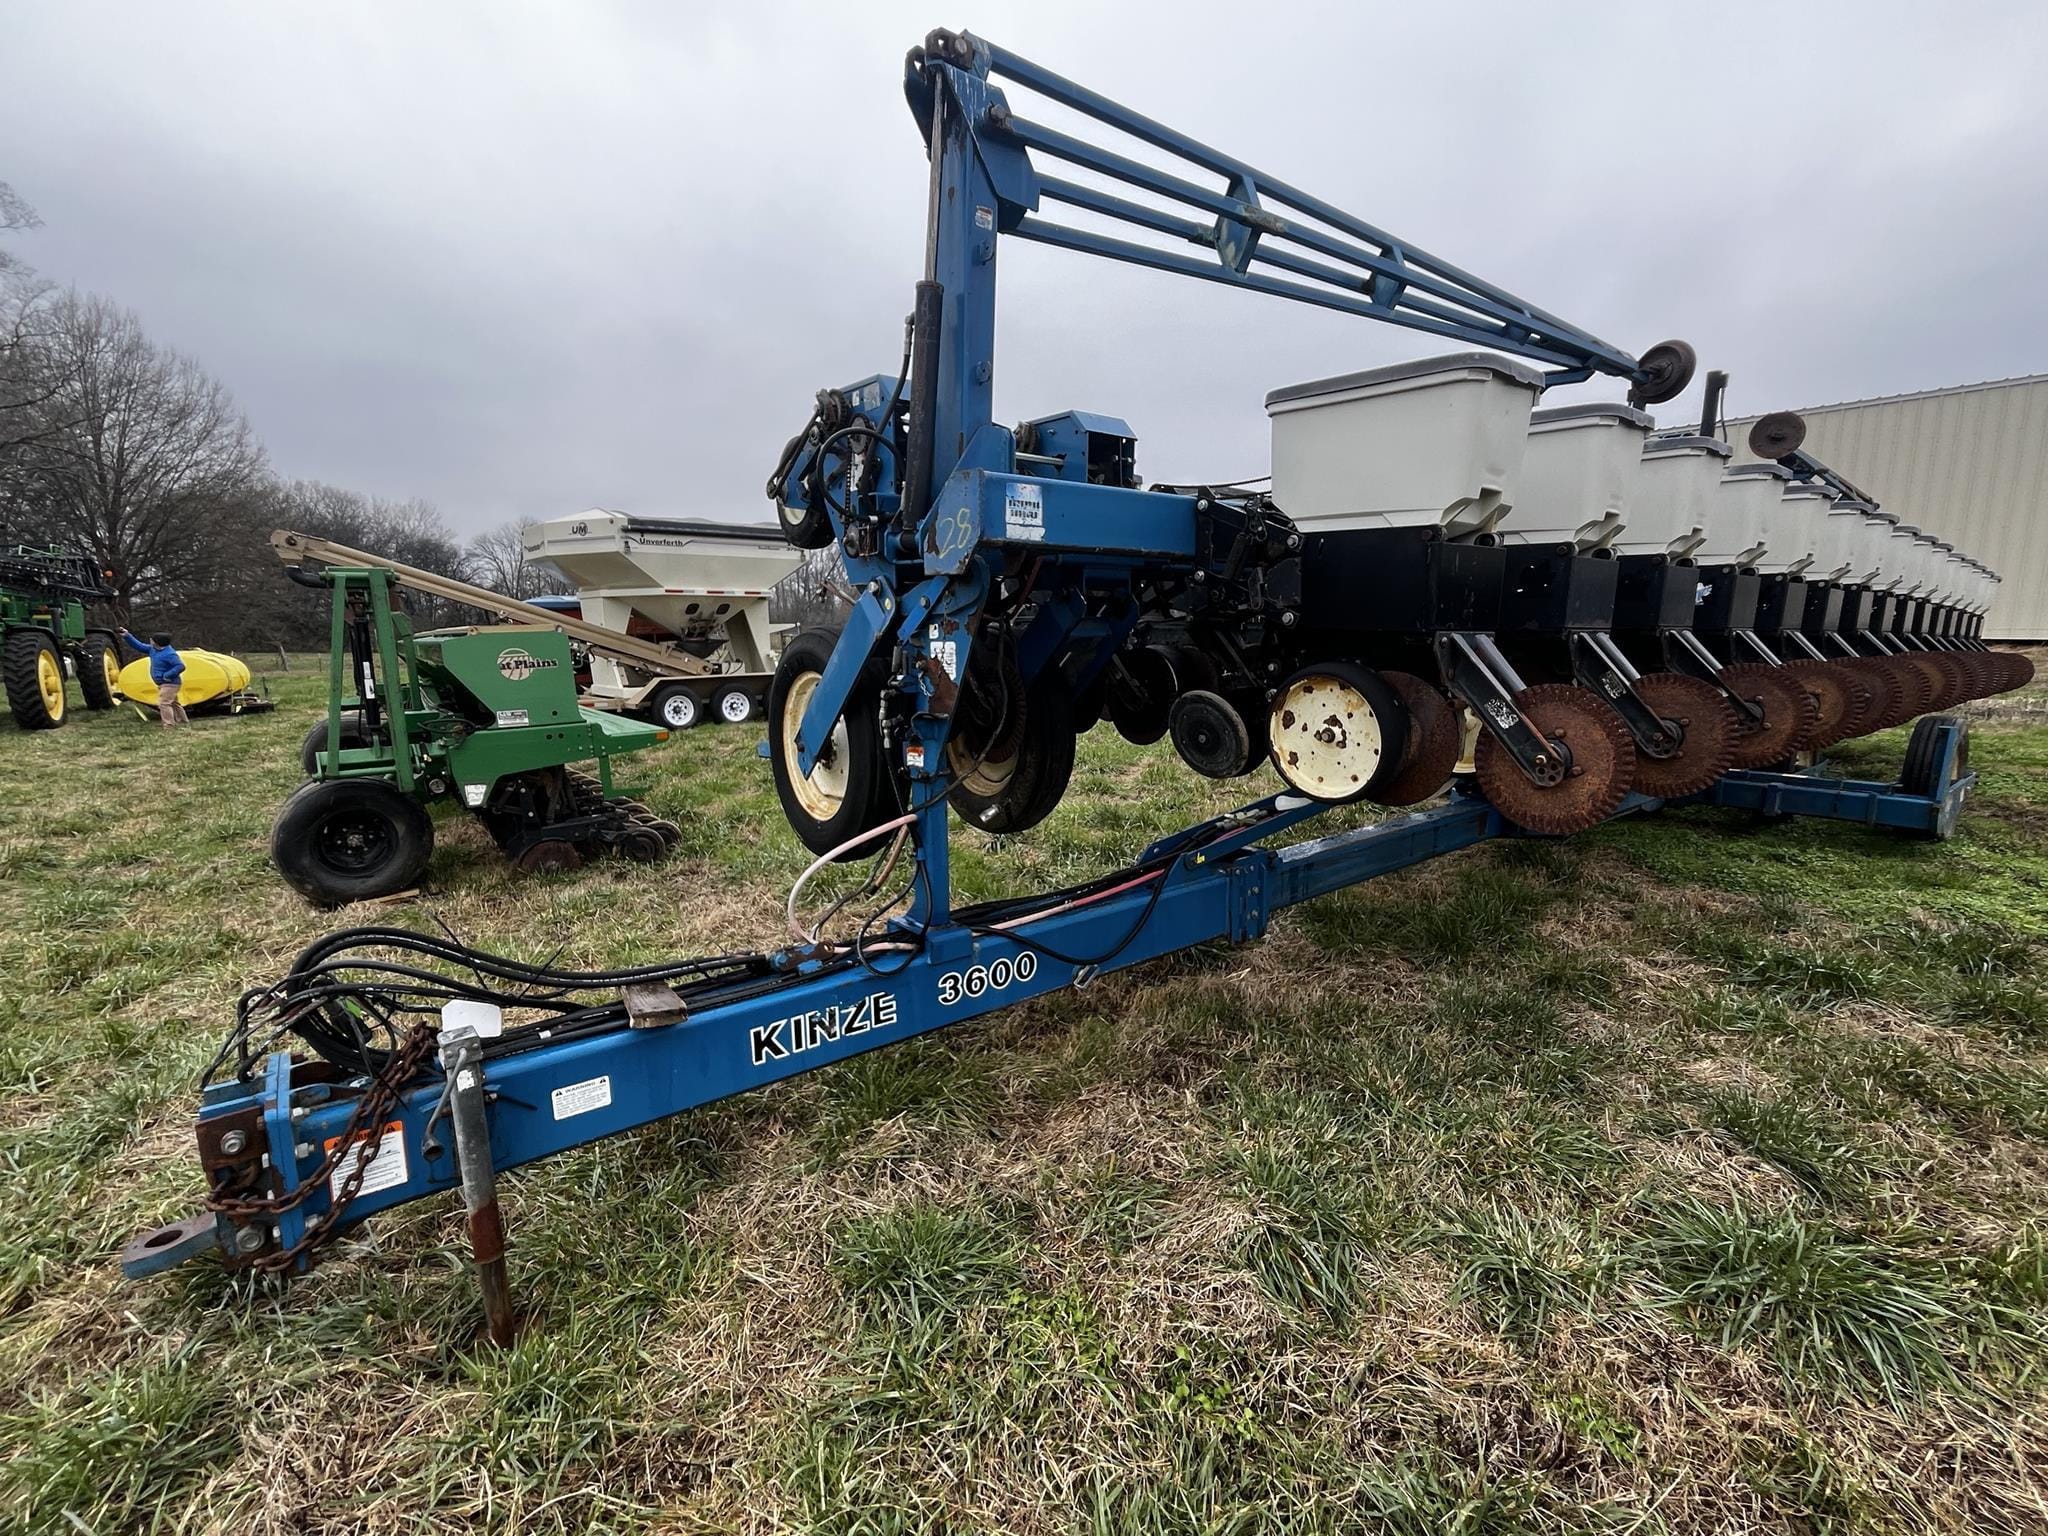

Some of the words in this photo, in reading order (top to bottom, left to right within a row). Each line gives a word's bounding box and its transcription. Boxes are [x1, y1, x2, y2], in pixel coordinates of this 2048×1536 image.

[571, 522, 588, 537] UM
[939, 507, 972, 559] 28
[639, 534, 684, 547] Unverferth
[514, 658, 557, 669] Plains
[750, 992, 897, 1066] KINZE
[938, 951, 1037, 1005] 3600
